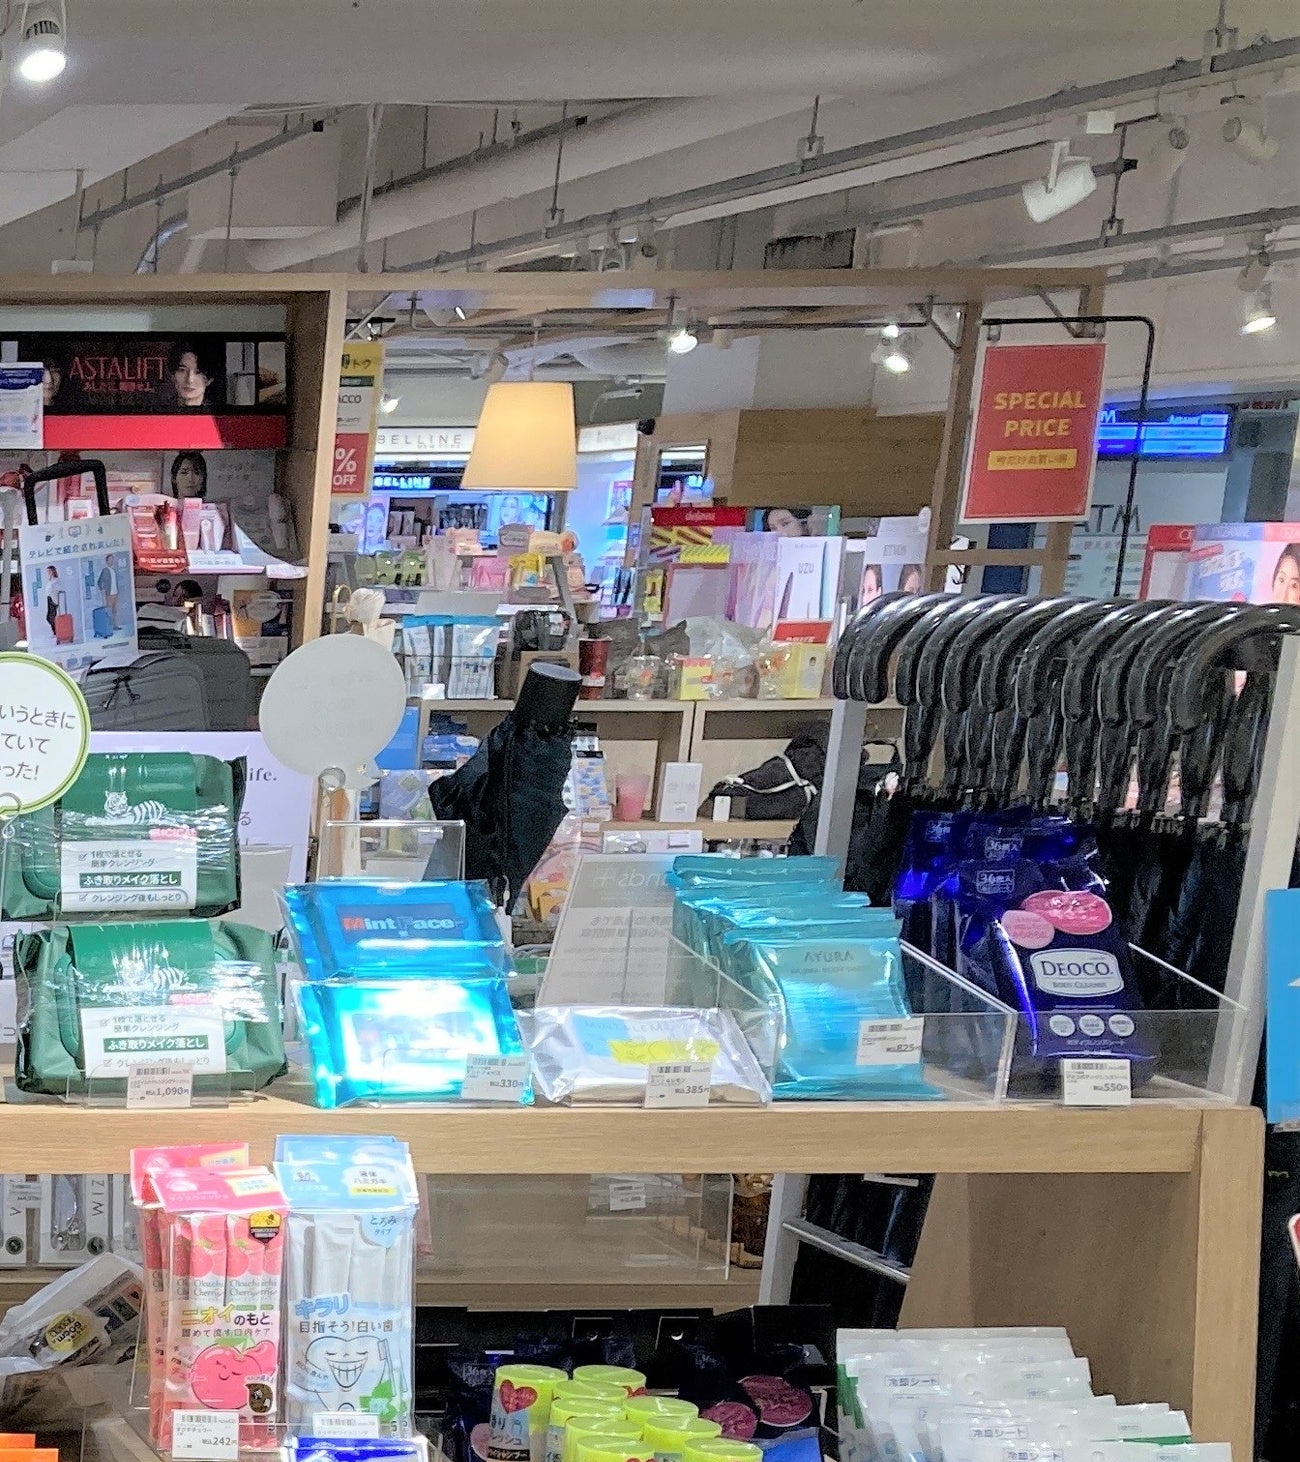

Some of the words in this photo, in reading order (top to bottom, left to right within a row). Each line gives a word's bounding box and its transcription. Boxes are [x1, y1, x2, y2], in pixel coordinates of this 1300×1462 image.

[69, 357, 168, 381] ASTALIFT
[994, 391, 1086, 410] SPECIAL
[1005, 418, 1072, 437] PRICE
[333, 476, 356, 486] OFF
[83, 874, 178, 886] ふき取りメイク落とし
[342, 914, 397, 932] Mint
[1041, 960, 1111, 977] DEOCO
[107, 1038, 205, 1049] ふき取りメイク落とし
[295, 1293, 349, 1320] キラリ
